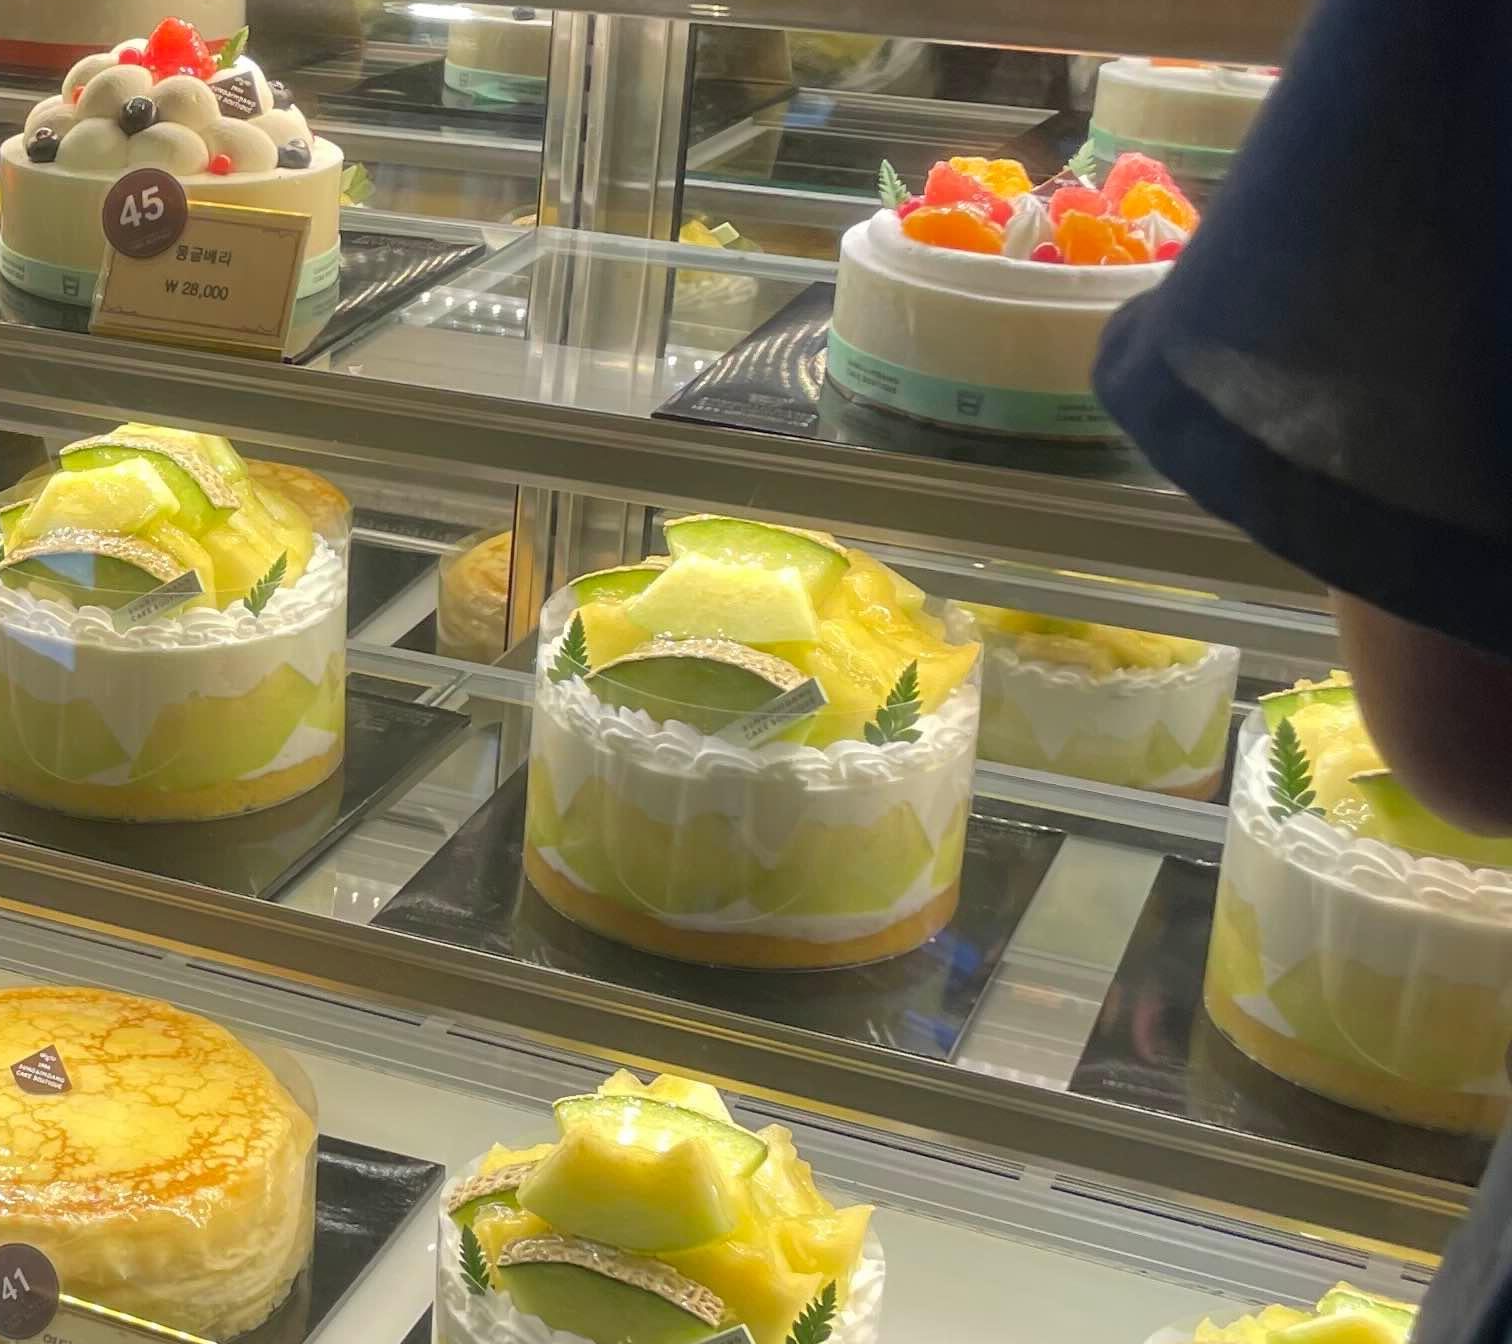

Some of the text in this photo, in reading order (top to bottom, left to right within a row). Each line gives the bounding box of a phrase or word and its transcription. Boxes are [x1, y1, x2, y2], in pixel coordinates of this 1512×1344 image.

[119, 185, 165, 228] 45
[182, 281, 229, 301] 28,000
[1, 1267, 31, 1302] 41
